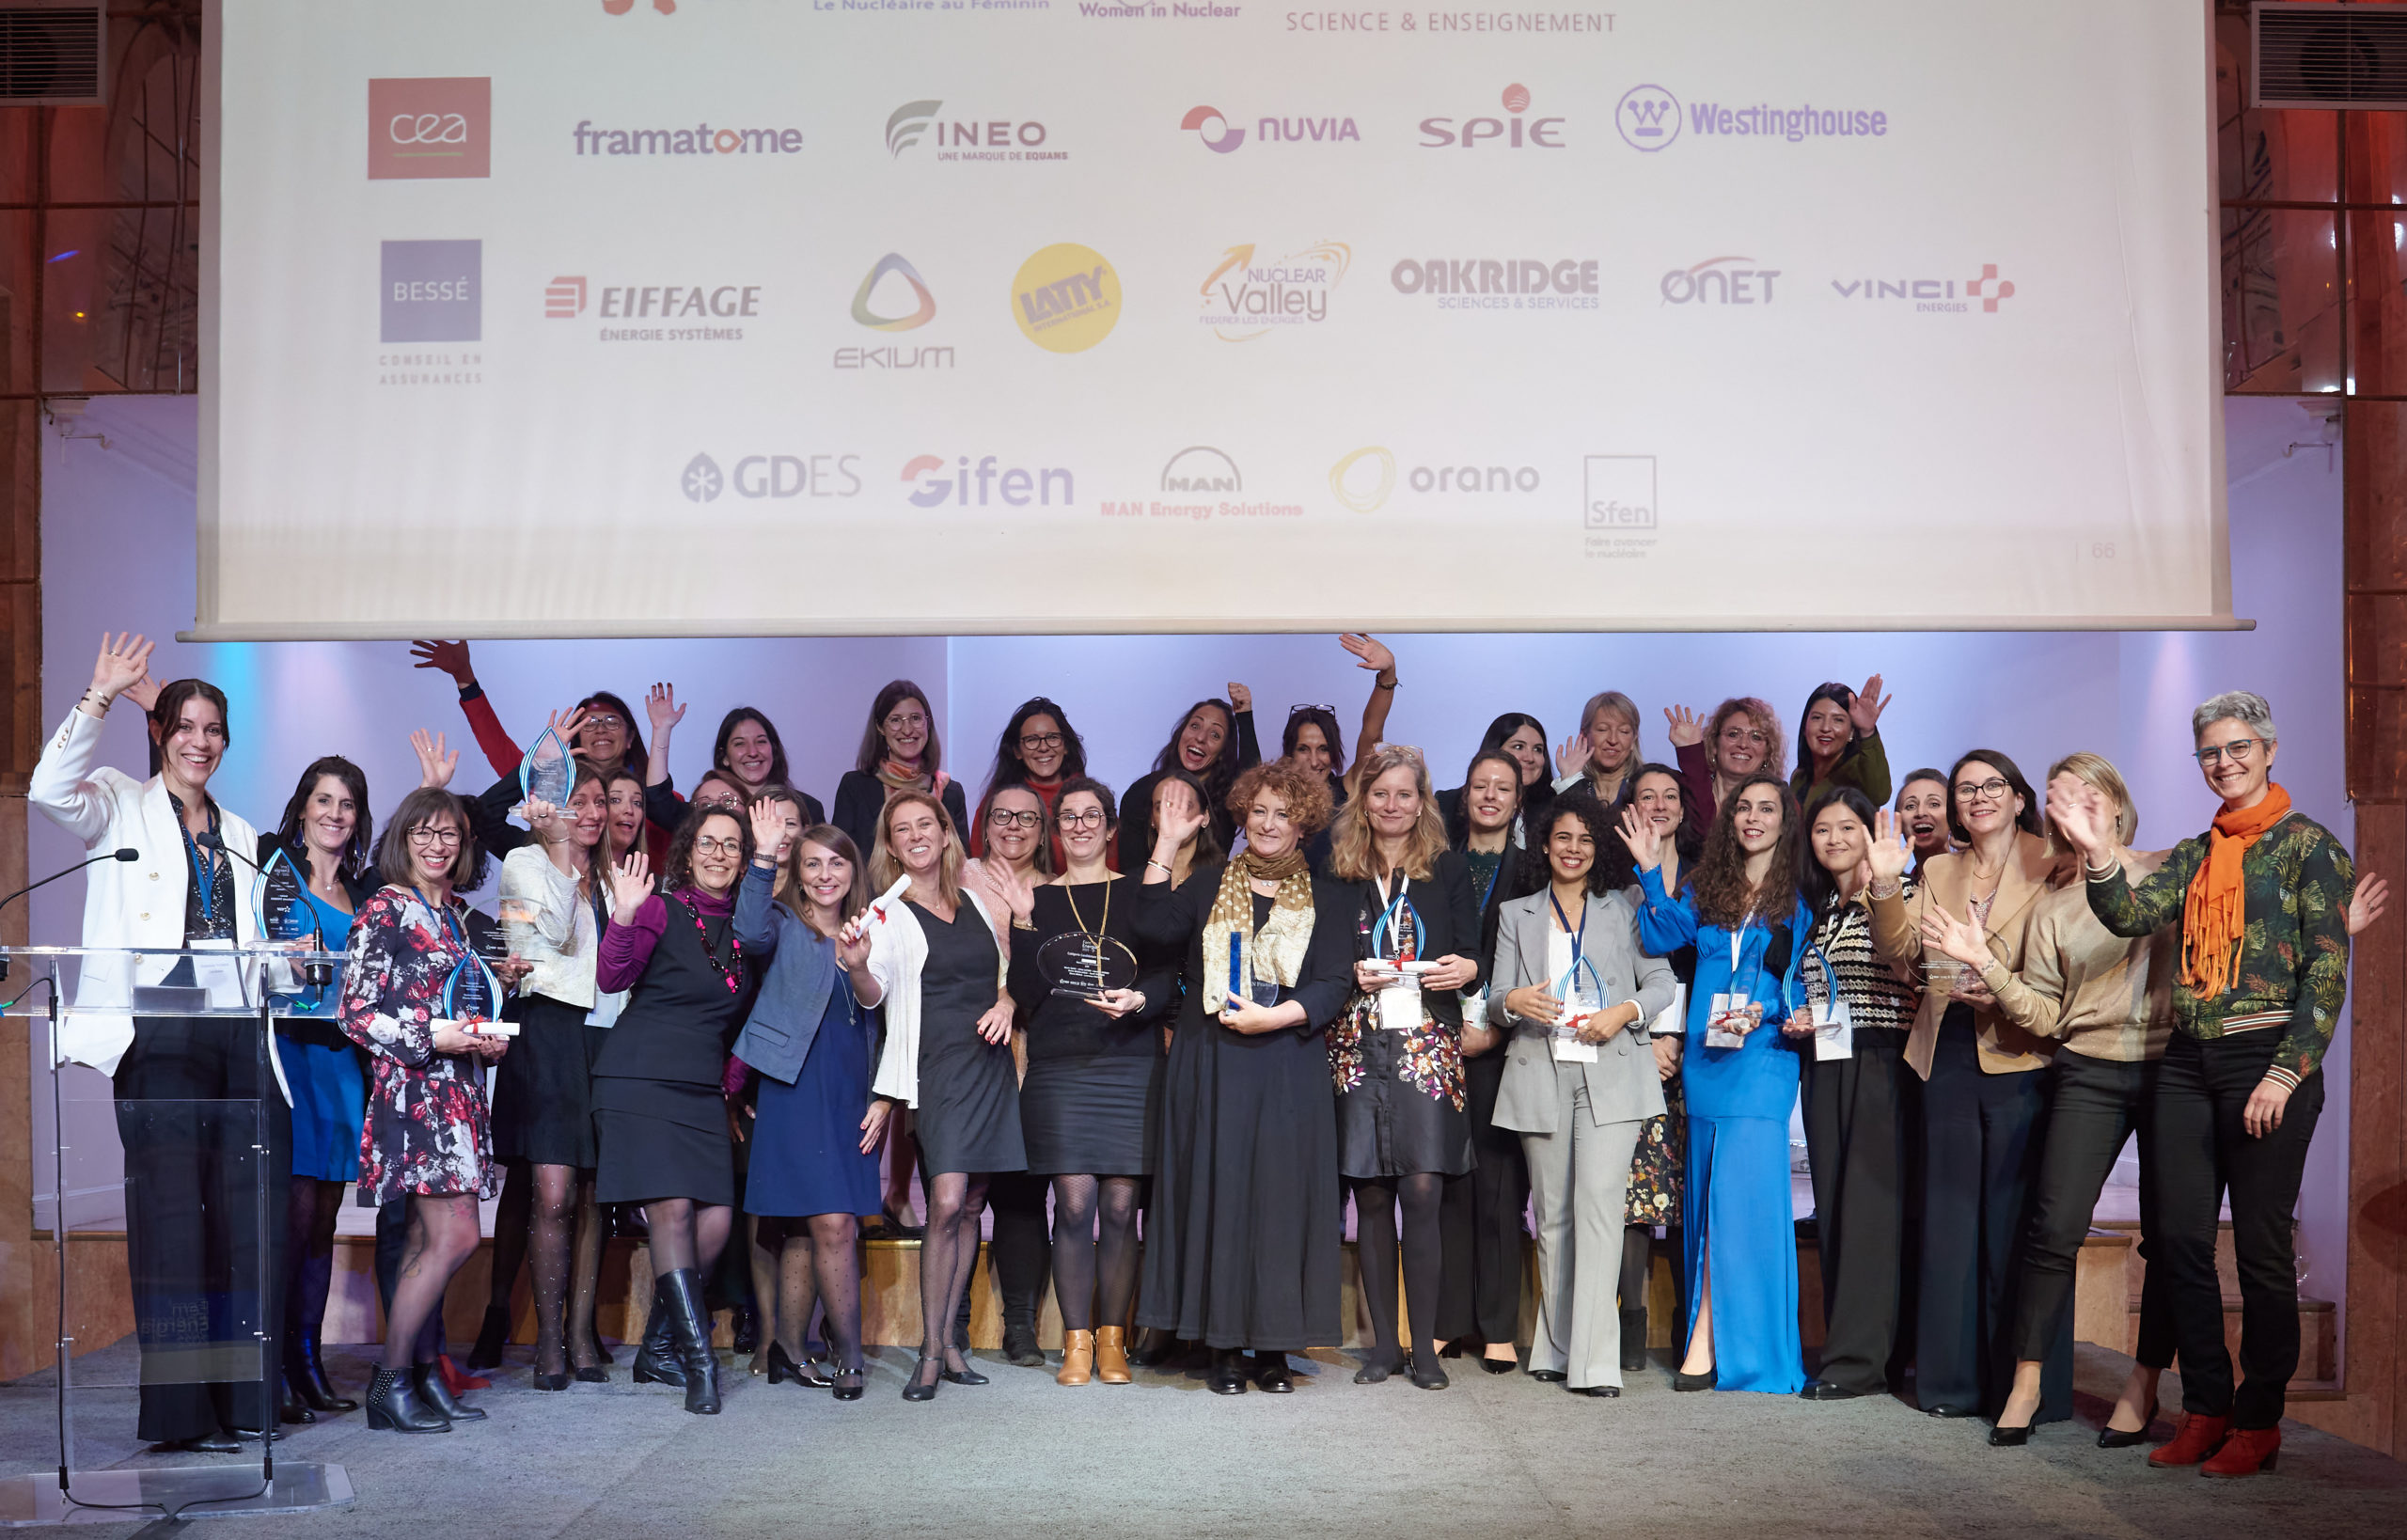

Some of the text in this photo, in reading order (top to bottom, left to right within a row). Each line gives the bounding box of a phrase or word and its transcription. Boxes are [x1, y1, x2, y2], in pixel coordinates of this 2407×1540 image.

[941, 0, 964, 9] au
[1079, 2, 1241, 17] Women in Nuclear
[1286, 12, 1616, 32] SCIENCE & ENSEIGNEMENT
[390, 113, 467, 144] cea
[1691, 102, 1888, 142] Westinghouse
[574, 120, 803, 155] framatome
[938, 120, 1046, 146] INEO
[937, 151, 1068, 163] UNE MARQUE DE EQUANS
[1247, 269, 1326, 283] NUCLEAR
[1391, 259, 1598, 294] OAKRIDGE
[394, 276, 469, 301] BESSÉ
[1019, 265, 1103, 324] LATTY
[1831, 279, 1954, 299] VINCI
[600, 286, 761, 318] EIFFAGE
[1221, 283, 1327, 322] Valley
[1438, 297, 1598, 308] SCIENCES & SERVICES
[1916, 303, 1968, 312] ENERGIES
[1242, 316, 1258, 324] LES
[600, 325, 744, 341] ÉNERGIE SYSTÈMES
[379, 354, 481, 366] CONSEIL EN
[834, 347, 953, 369] EKIUM
[380, 373, 482, 385] ASSURANCES
[733, 455, 862, 498] GDES
[900, 455, 1074, 509] Gifen
[1168, 478, 1235, 492] MAN
[1409, 465, 1540, 493] orano
[1100, 501, 1304, 519] MAN Energy Solutions
[1591, 500, 1650, 525] Sfen
[1584, 537, 1658, 547] Faire avancer
[2091, 542, 2116, 558] 66
[1584, 548, 1647, 558] le nucléaire
